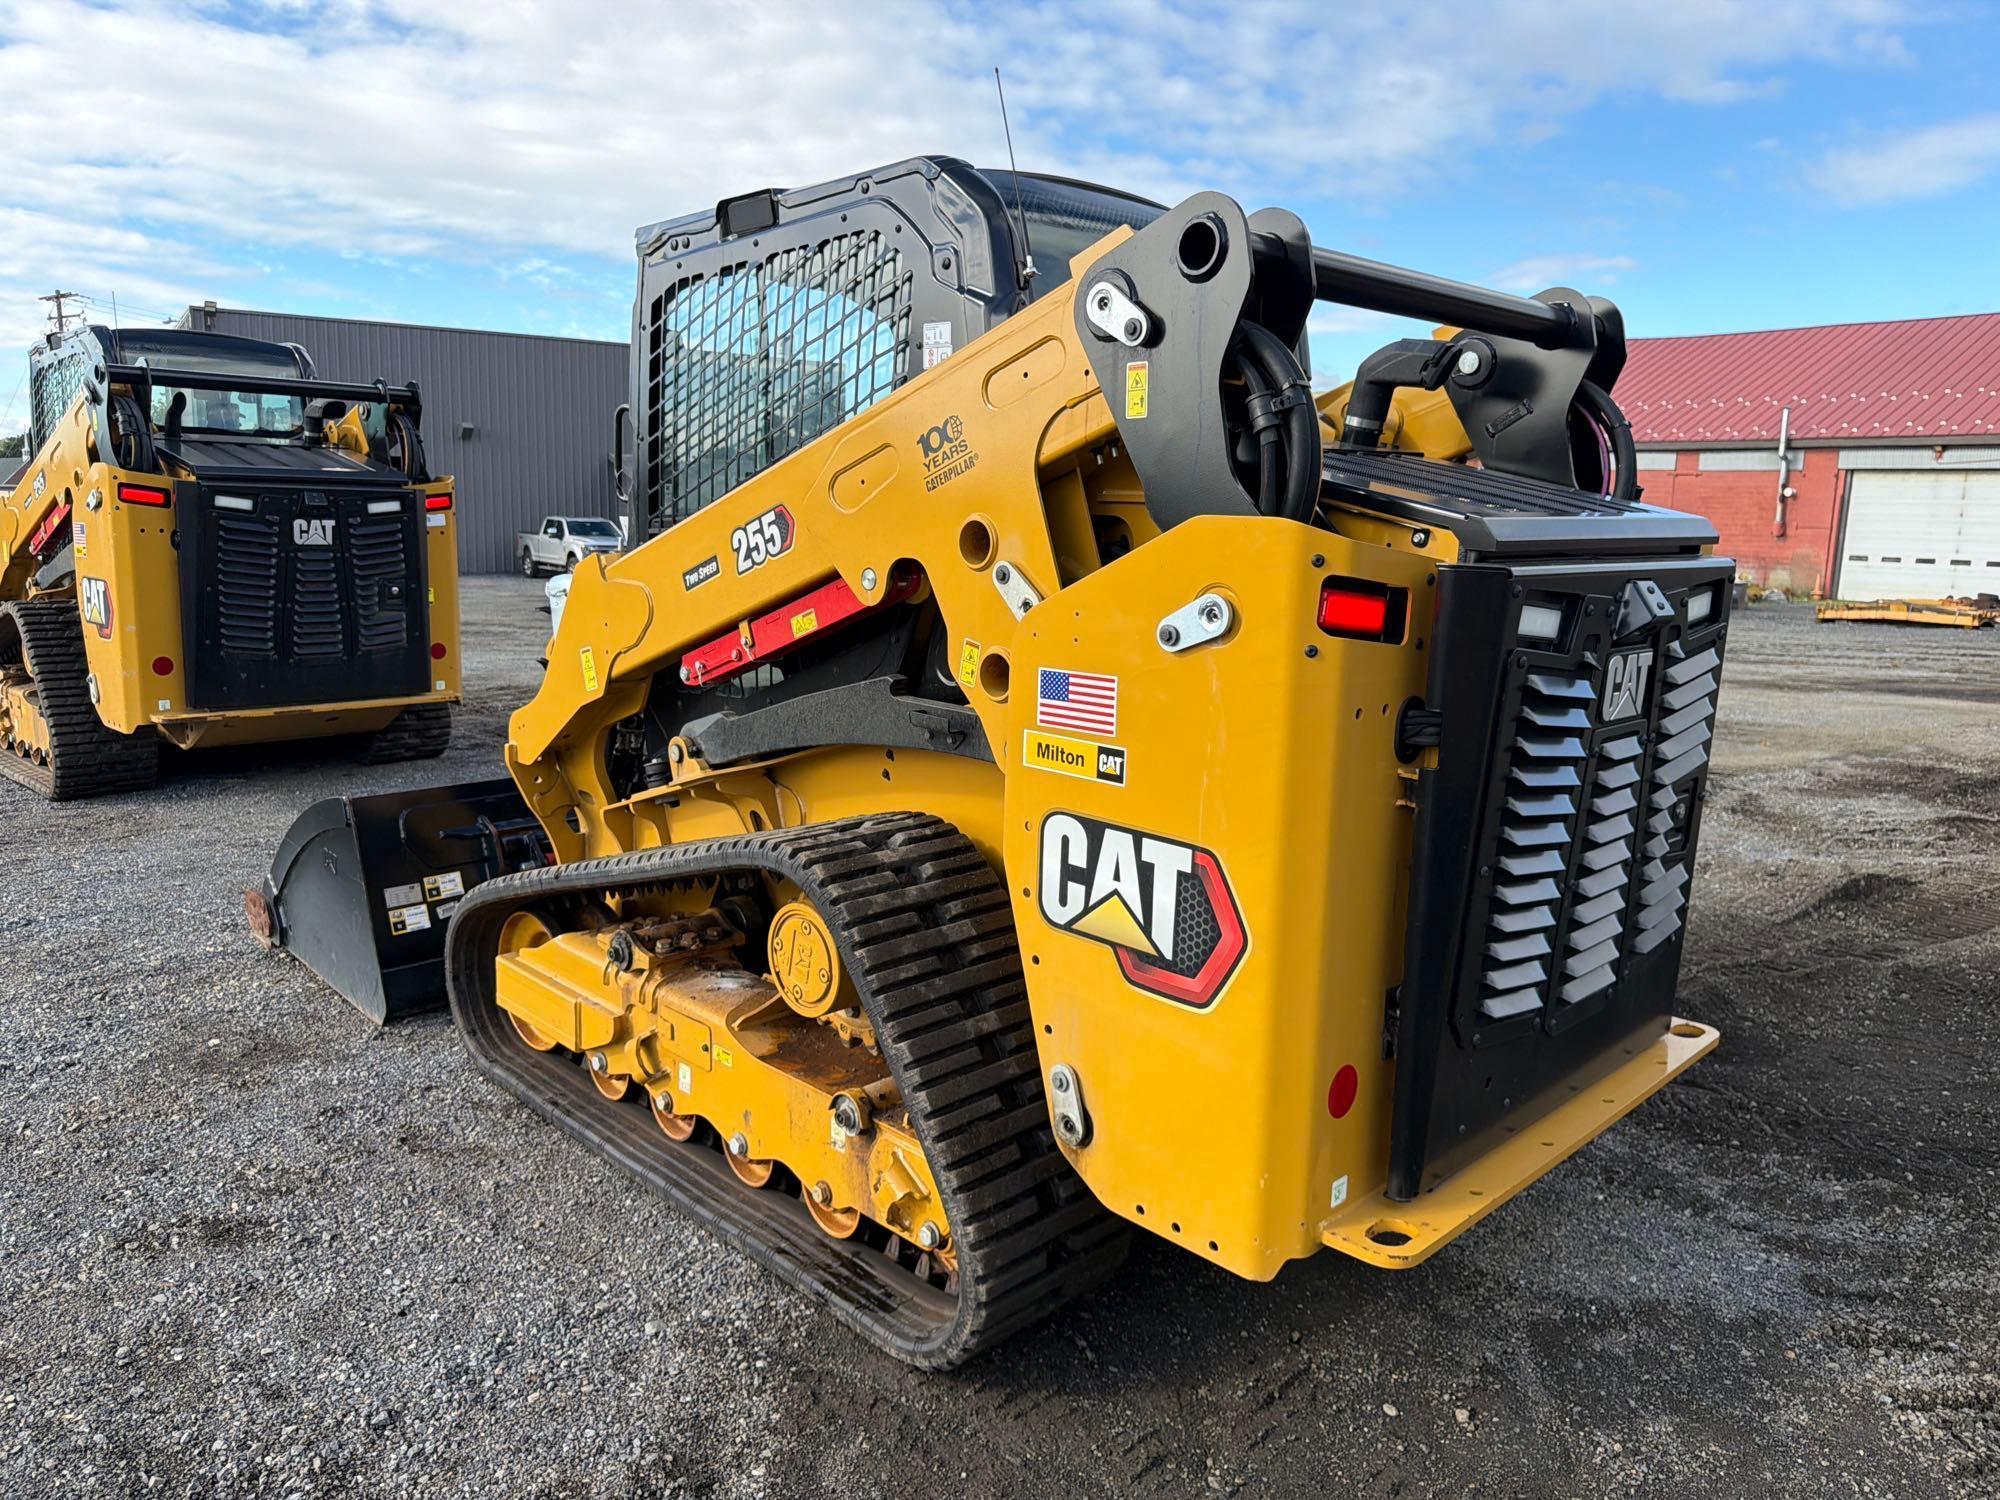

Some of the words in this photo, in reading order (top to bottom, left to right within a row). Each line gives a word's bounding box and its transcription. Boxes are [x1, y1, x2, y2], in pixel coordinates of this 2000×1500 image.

[916, 415, 963, 459] 100
[922, 440, 968, 473] YEARS
[293, 518, 336, 545] CAT
[732, 510, 782, 574] 255
[82, 577, 105, 625] CAT
[1602, 652, 1654, 721] CAT
[1037, 742, 1085, 767] Milton
[1099, 753, 1124, 776] CAT
[1041, 814, 1193, 961] CAT
